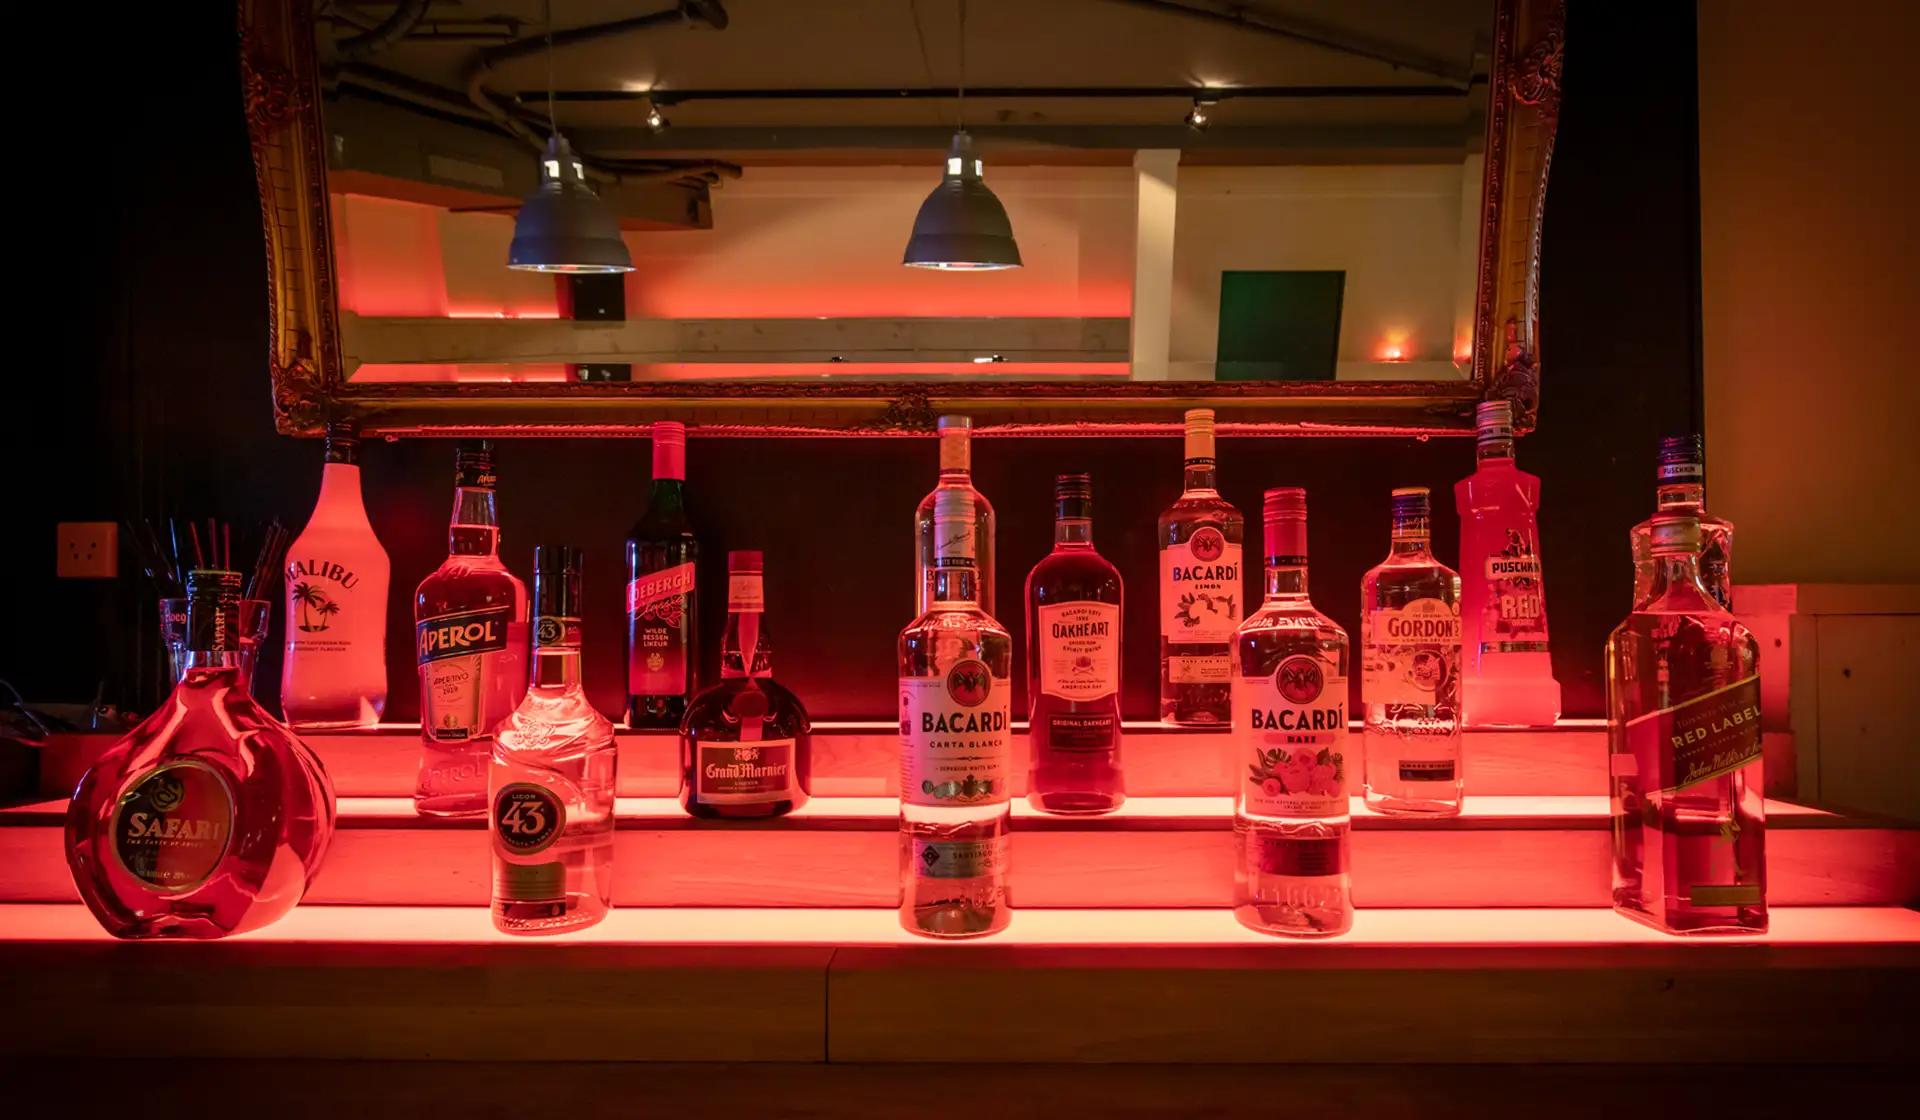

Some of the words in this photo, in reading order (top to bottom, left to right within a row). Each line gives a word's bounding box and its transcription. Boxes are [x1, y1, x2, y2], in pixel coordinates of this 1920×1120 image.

[1173, 562, 1238, 581] BACARDÍ
[1492, 561, 1540, 574] PUSCHKN
[1501, 594, 1540, 619] RED
[212, 606, 225, 652] SAFARI
[537, 624, 556, 639] 43
[1052, 621, 1109, 639] OAKHEART
[1388, 616, 1460, 638] GORDON'S
[419, 620, 497, 657] APEROL
[433, 671, 470, 686] APERITIVO
[922, 705, 1007, 733] BACARDÍ
[1052, 719, 1082, 727] ORIGINAL
[1083, 719, 1112, 727] OAKHEART
[1251, 703, 1344, 730] BACARDÍ
[1671, 727, 1707, 748] RED
[1711, 706, 1761, 734] LABEL
[969, 740, 1003, 748] BLANCA
[705, 763, 740, 779] Grand
[740, 762, 787, 779] Marnier
[127, 812, 222, 840] SAFARI
[501, 801, 546, 834] 43
